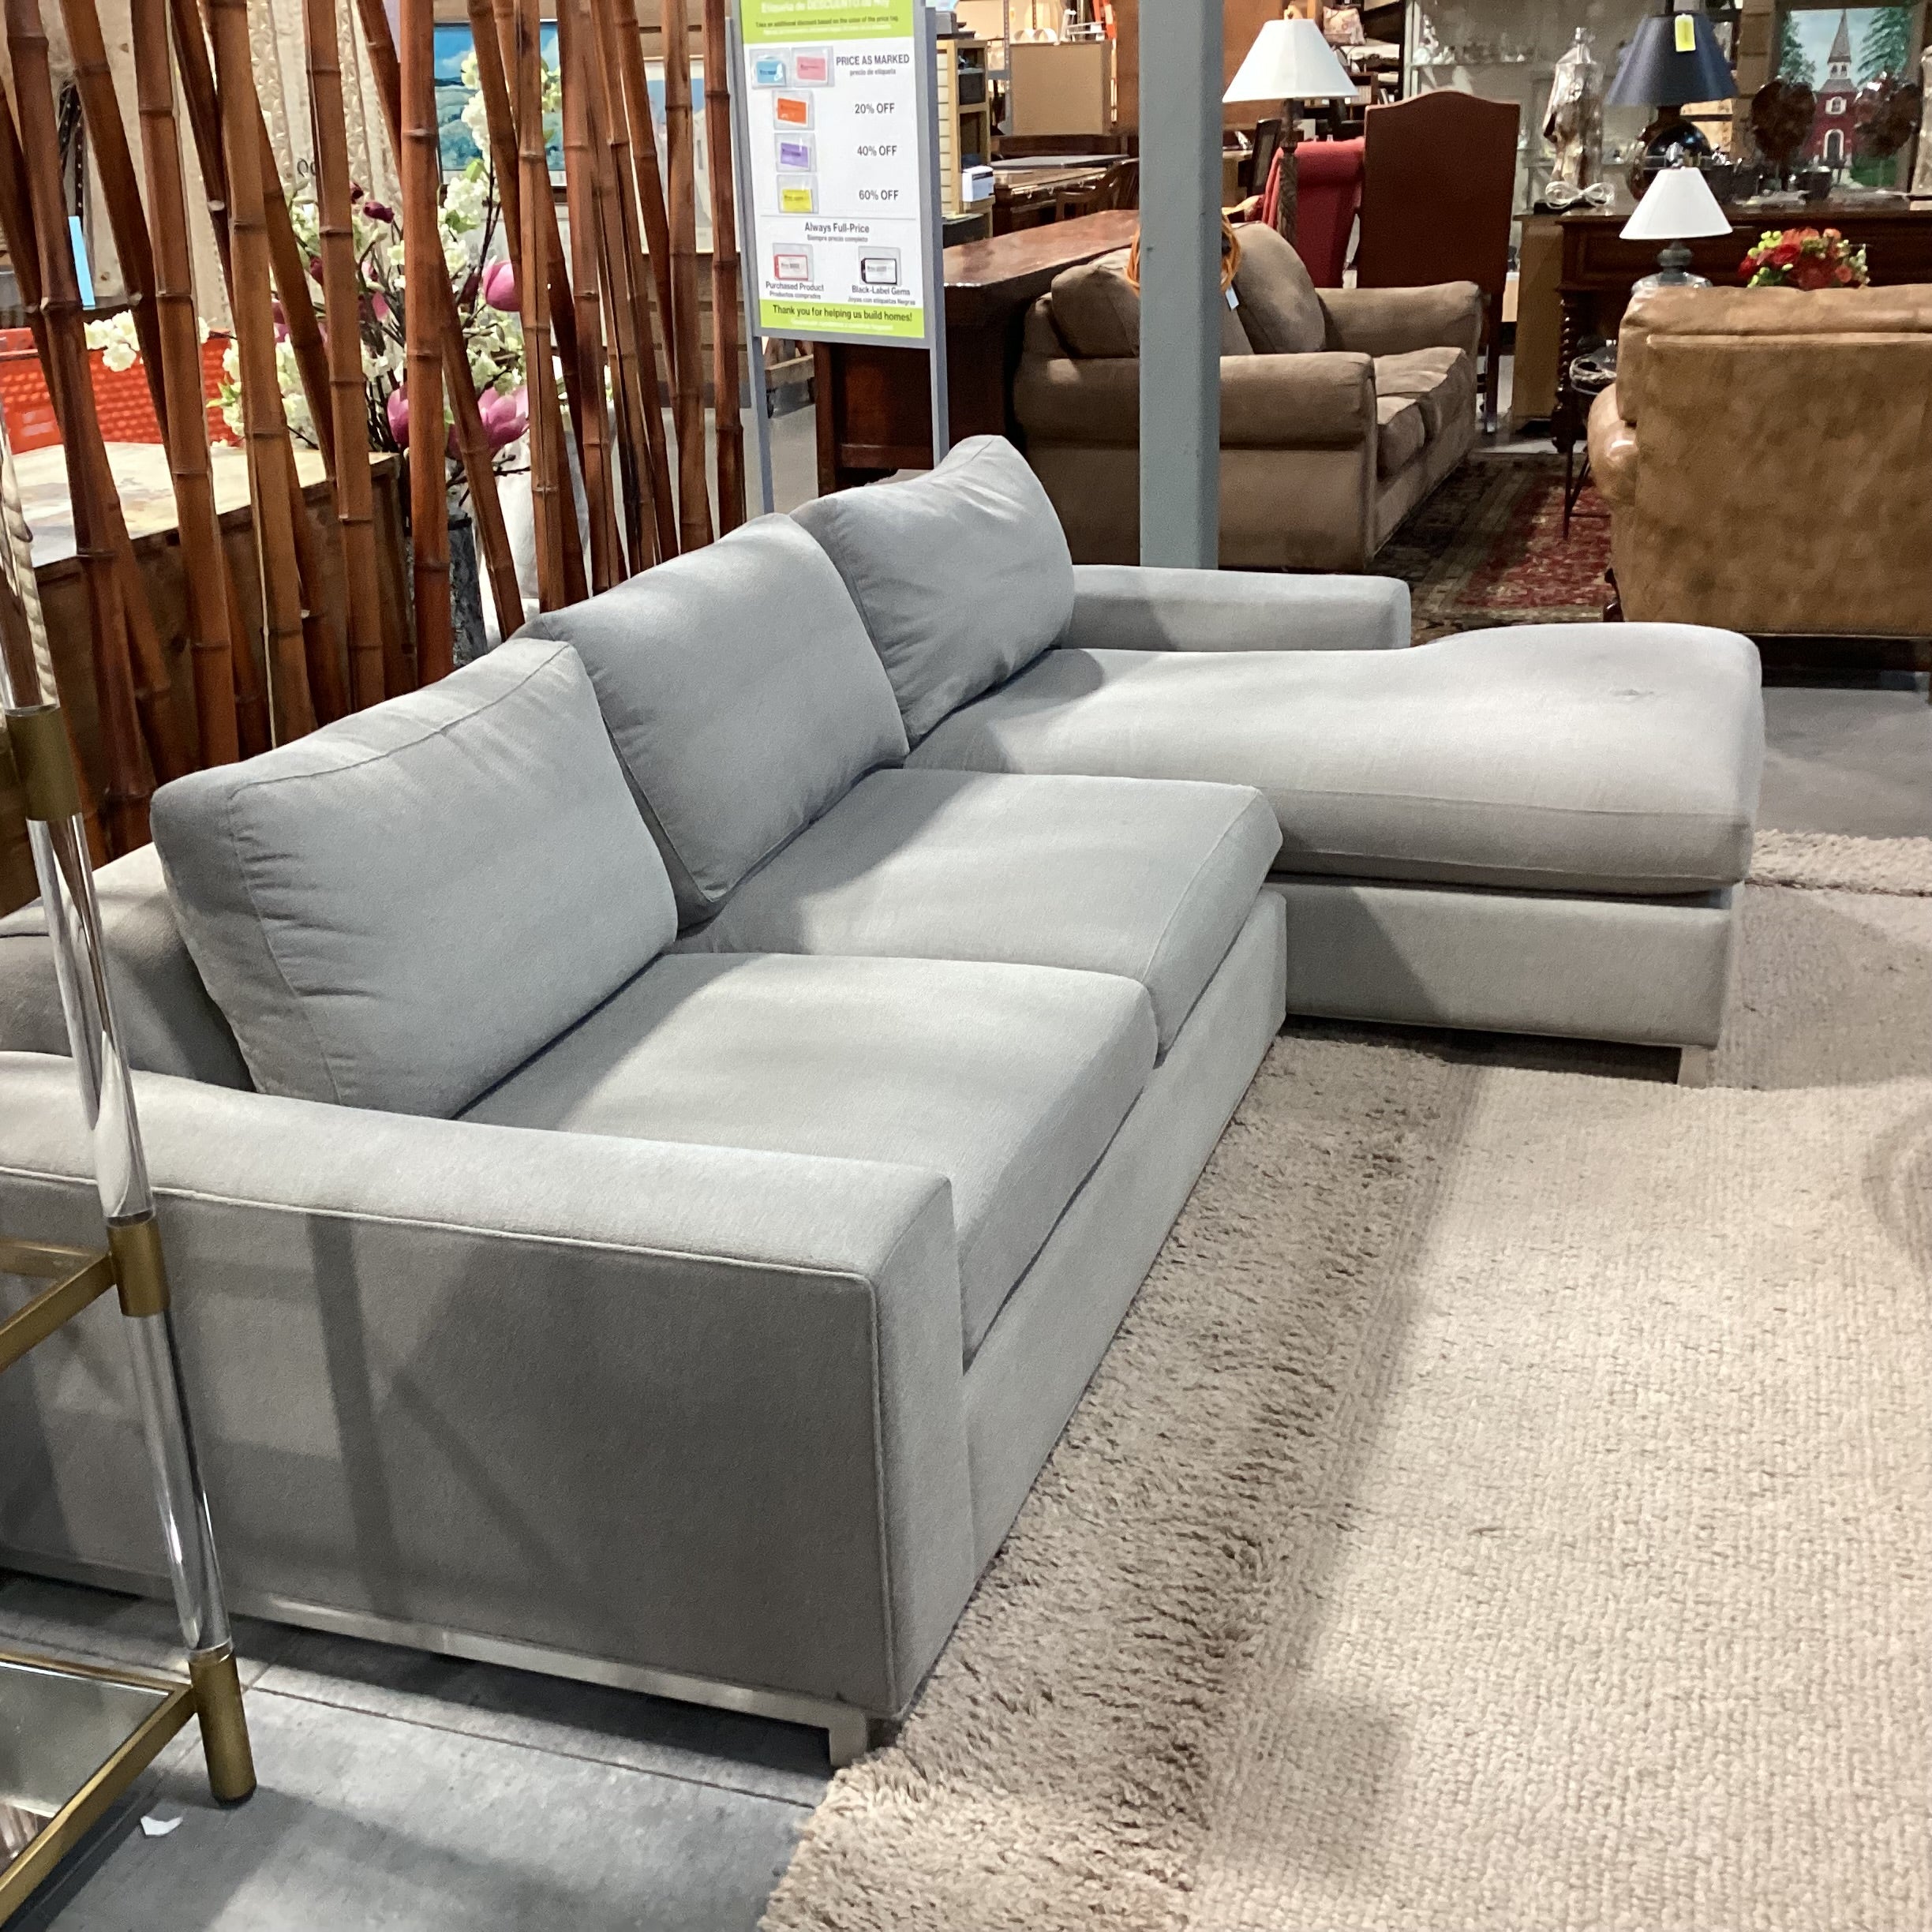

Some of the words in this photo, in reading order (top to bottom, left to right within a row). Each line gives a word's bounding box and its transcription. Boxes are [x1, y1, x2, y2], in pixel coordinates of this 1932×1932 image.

[836, 56, 859, 66] PRICE
[862, 55, 872, 65] AS
[874, 54, 910, 64] MARKED
[855, 103, 874, 114] 20%
[876, 103, 895, 114] OFF
[857, 146, 877, 156] 40%
[878, 145, 897, 155] OFF
[859, 190, 878, 200] 60%
[881, 189, 899, 200] OFF
[805, 222, 831, 234] Always
[833, 223, 870, 234] Full-Price
[766, 281, 798, 290] Purchased
[799, 283, 824, 291] Product
[852, 285, 889, 295] Black-Label
[891, 286, 910, 296] Gems
[773, 305, 795, 314] Thank
[797, 308, 810, 317] you
[811, 307, 822, 316] for
[824, 308, 851, 320] helping
[863, 310, 882, 320] build
[884, 311, 912, 322] homes!
